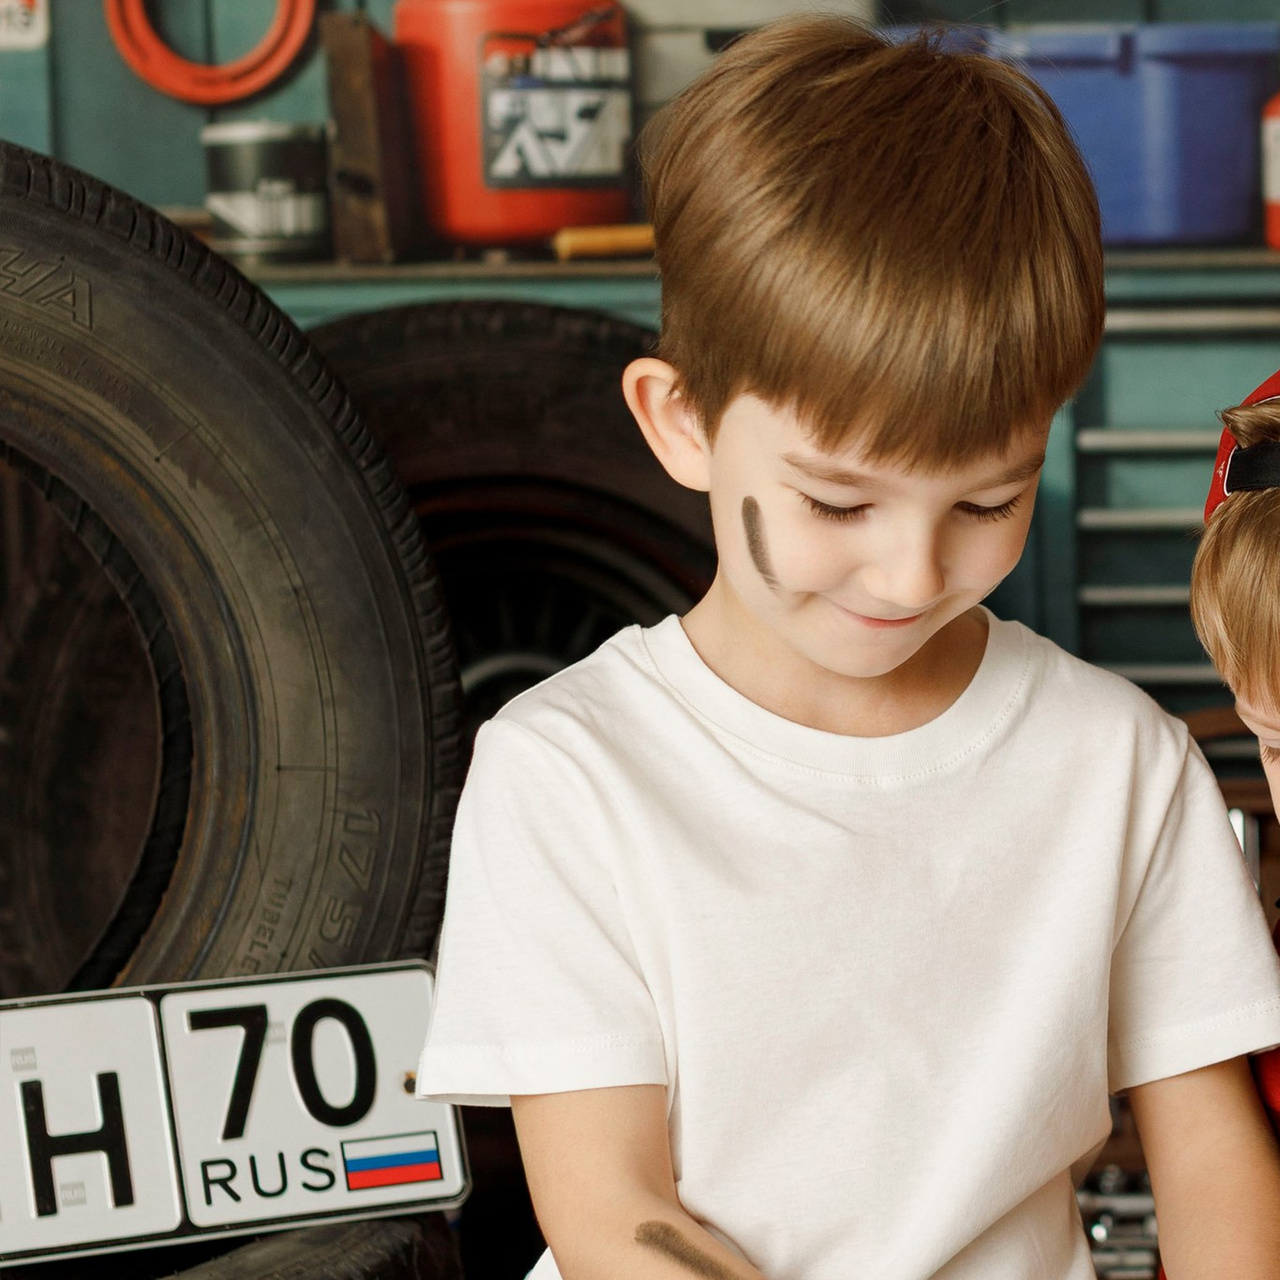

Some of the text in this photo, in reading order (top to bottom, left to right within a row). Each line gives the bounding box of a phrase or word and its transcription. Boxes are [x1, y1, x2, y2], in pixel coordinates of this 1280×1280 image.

[18, 997, 378, 1218] H 70
[200, 1147, 337, 1206] RUS
